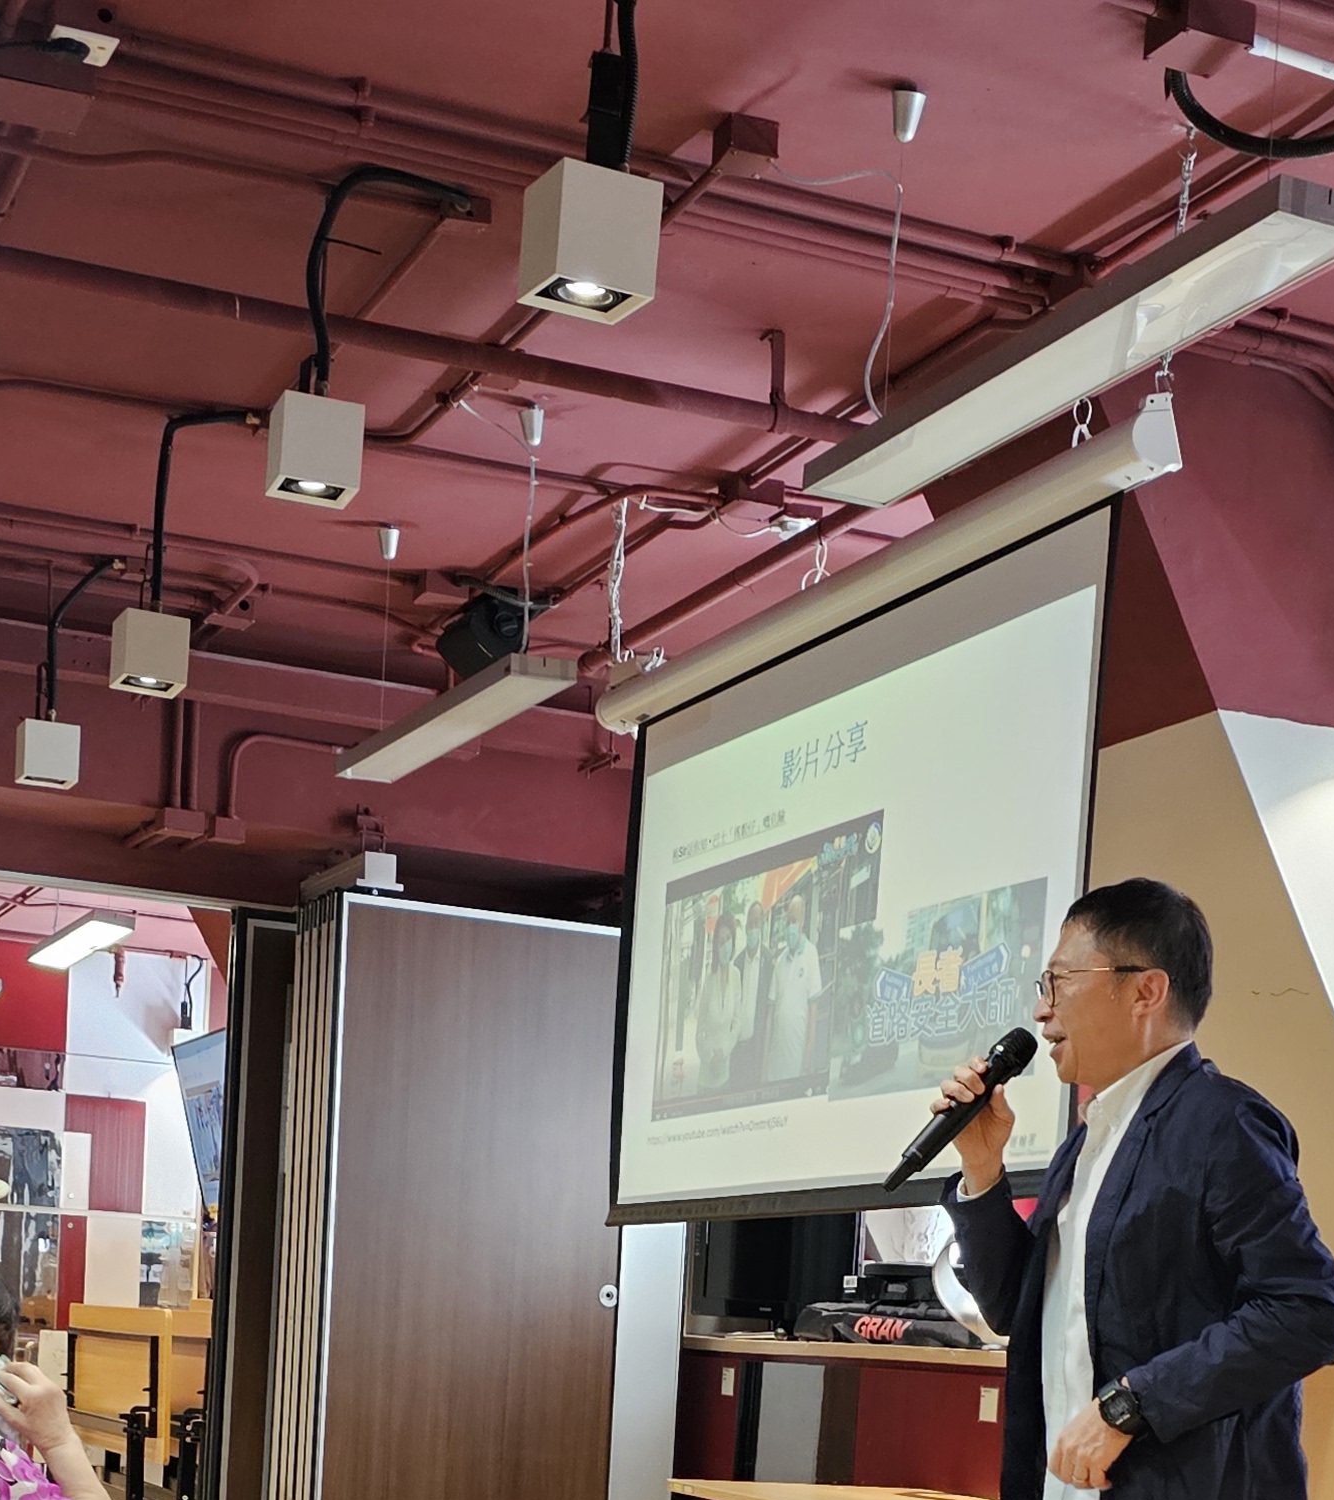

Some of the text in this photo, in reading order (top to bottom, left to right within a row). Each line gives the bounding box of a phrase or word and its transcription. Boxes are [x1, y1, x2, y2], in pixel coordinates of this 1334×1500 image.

[780, 720, 868, 789] 影片分享
[912, 946, 963, 996] 長者
[866, 978, 1016, 1046] 道路安全大師
[854, 1315, 913, 1341] GRAN
